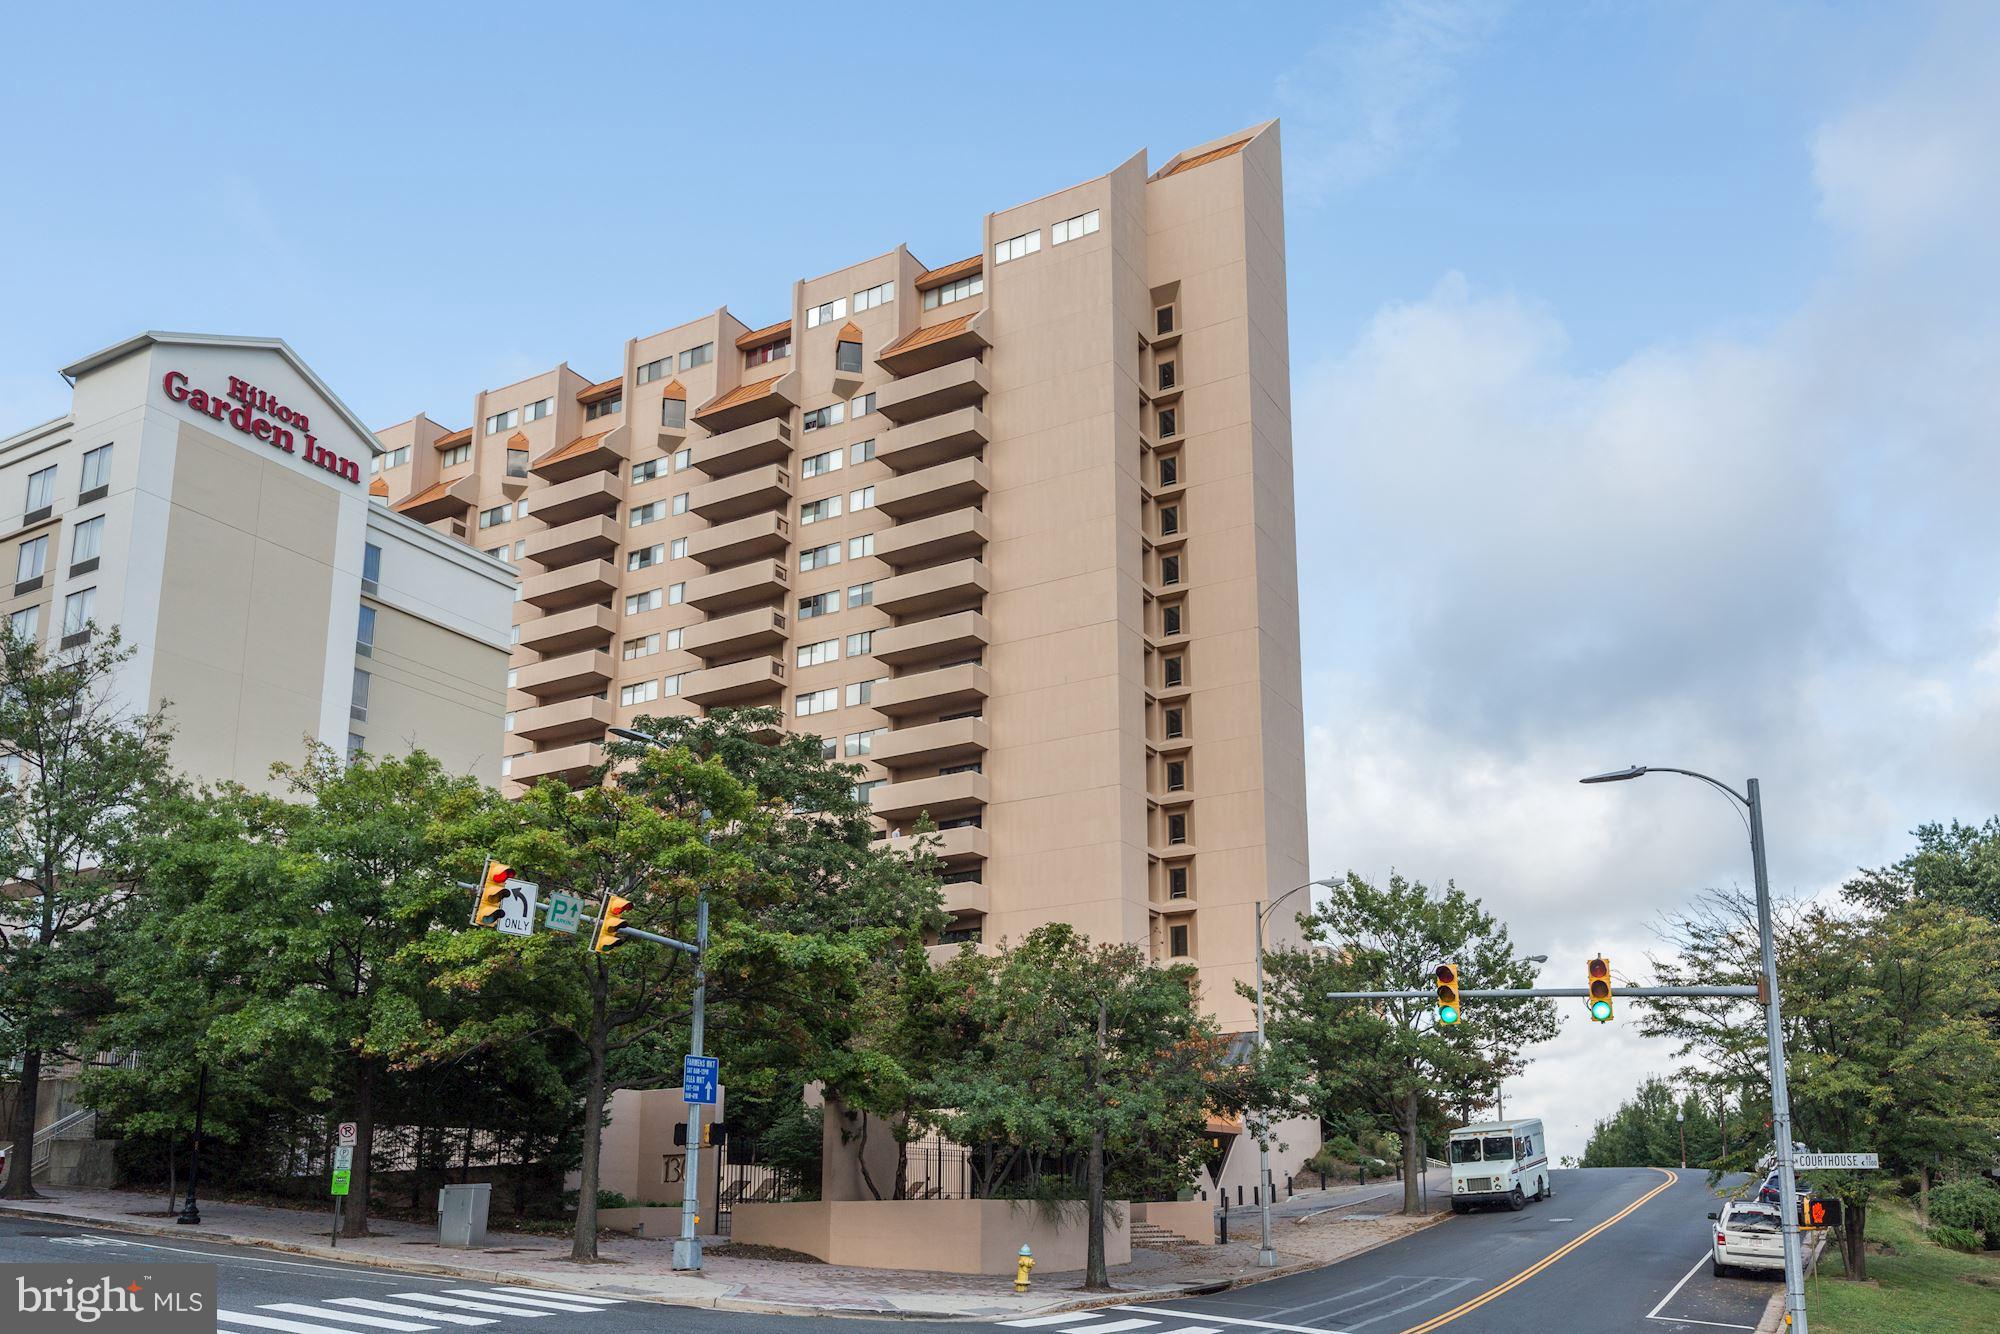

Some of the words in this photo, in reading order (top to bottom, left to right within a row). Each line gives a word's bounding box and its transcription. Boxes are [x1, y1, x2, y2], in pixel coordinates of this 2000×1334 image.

[227, 375, 310, 433] Hilton
[162, 371, 295, 454] Garden
[301, 433, 360, 484] Inn
[505, 918, 530, 931] ONLY
[1799, 1155, 1859, 1167] COURTHOUSE
